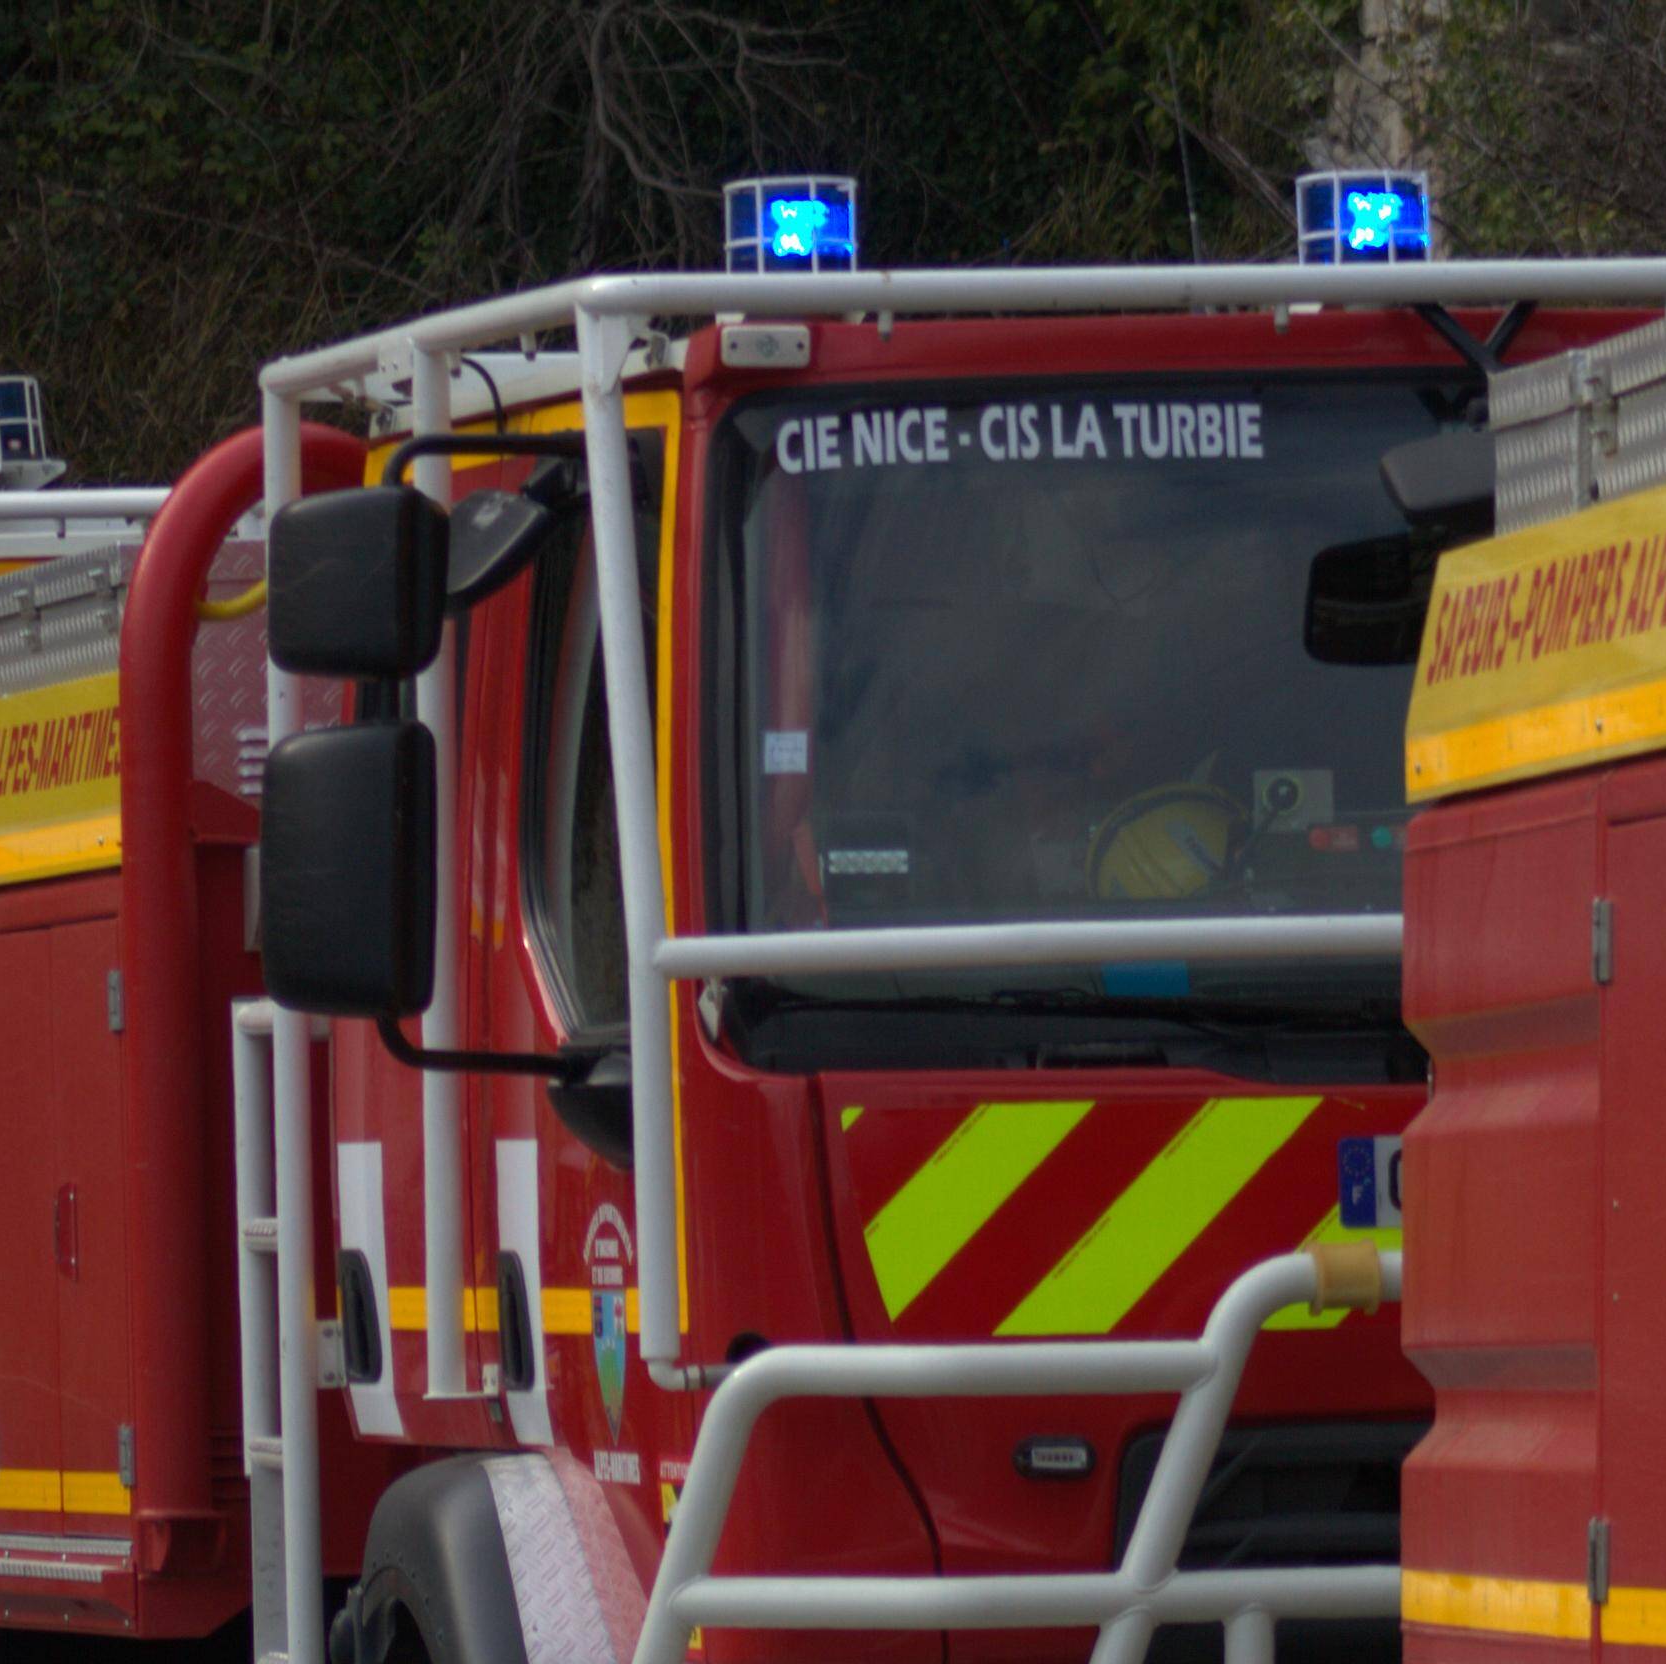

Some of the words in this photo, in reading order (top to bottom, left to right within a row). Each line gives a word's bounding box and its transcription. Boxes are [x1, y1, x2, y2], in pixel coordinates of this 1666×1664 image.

[776, 416, 842, 475] CIE
[851, 407, 950, 467] NICE
[979, 404, 1042, 462] CIS
[1049, 404, 1107, 459] LA
[1112, 403, 1265, 459] TURBIE
